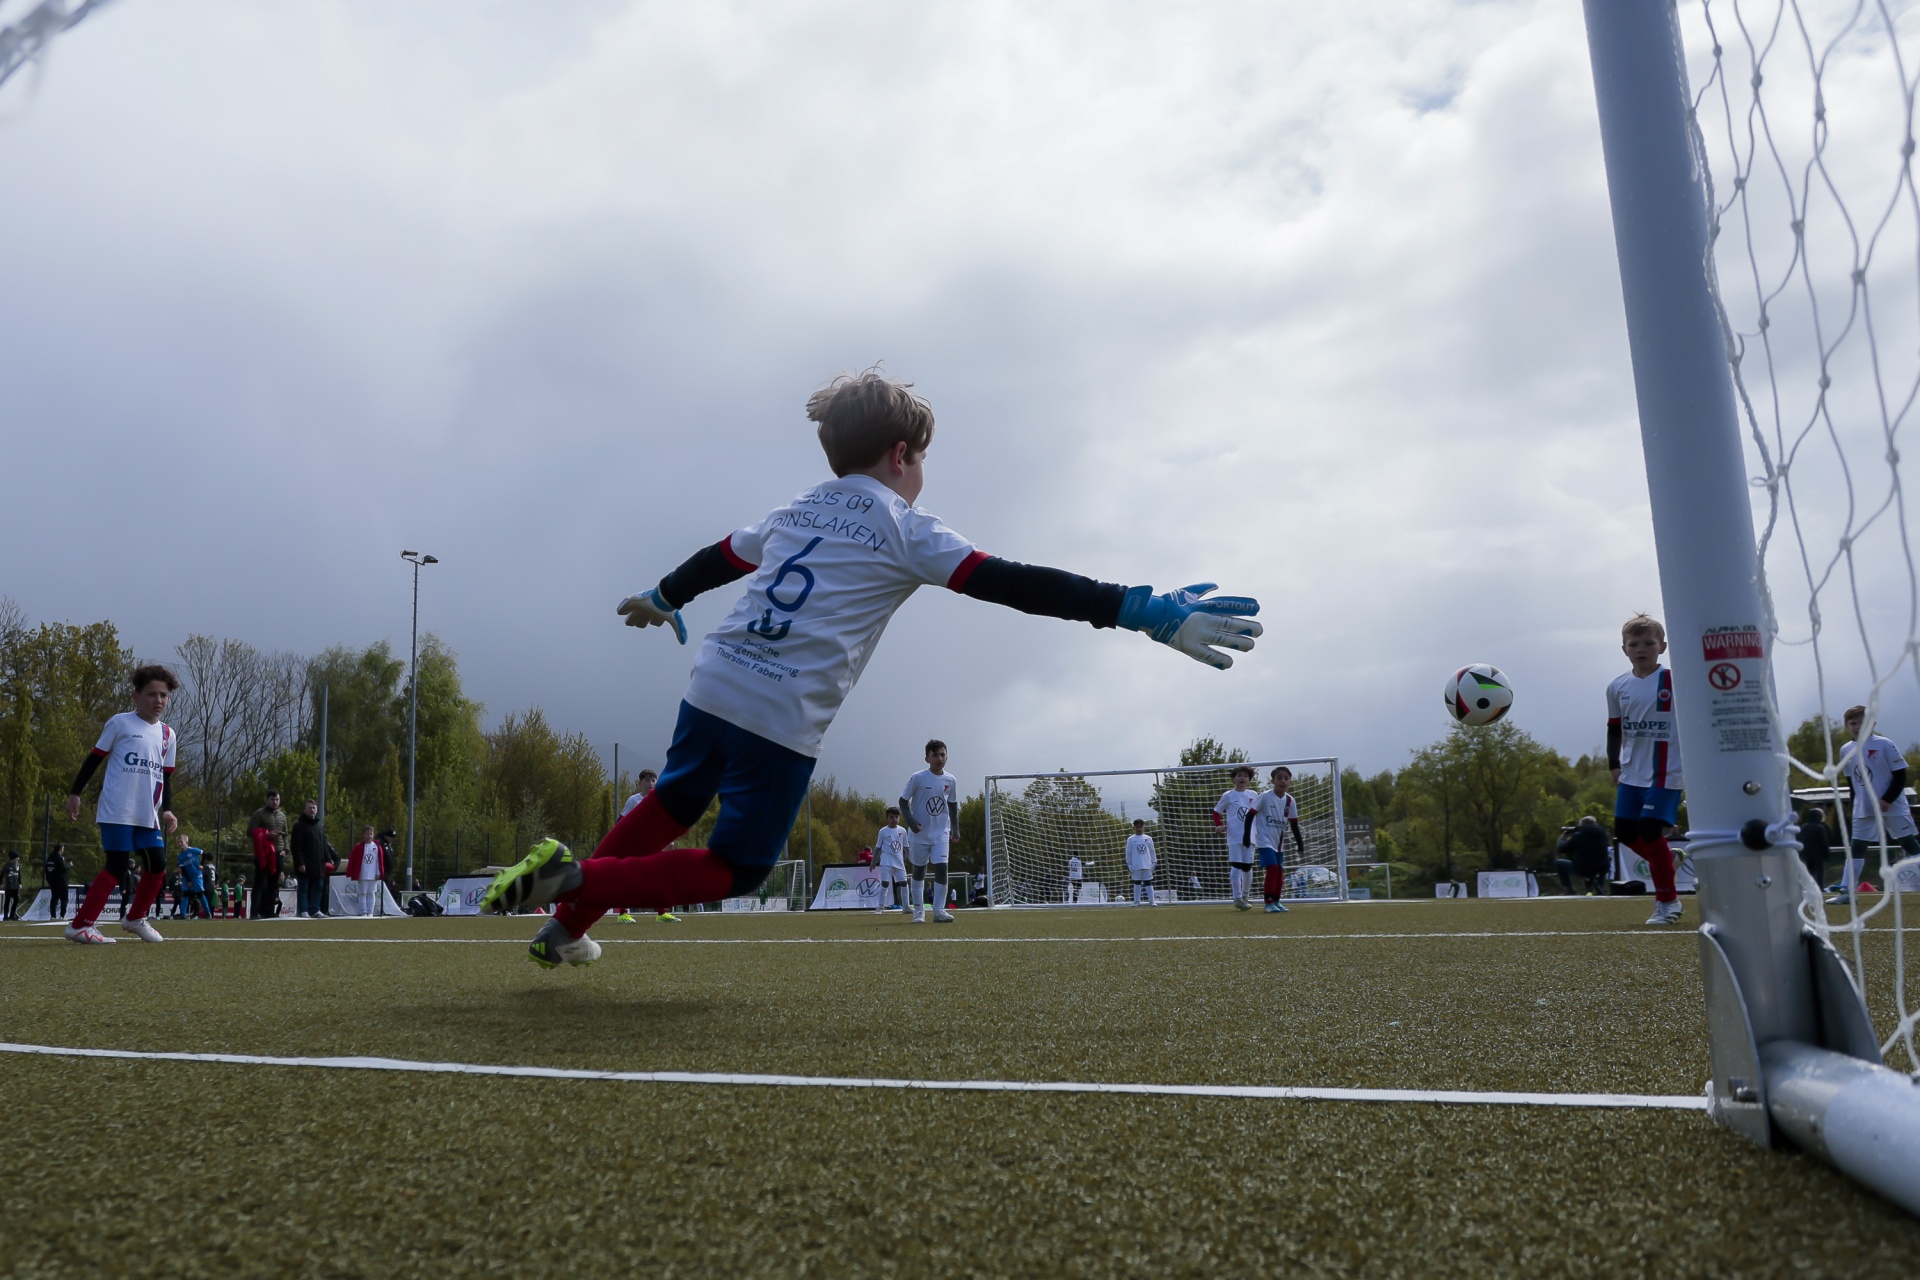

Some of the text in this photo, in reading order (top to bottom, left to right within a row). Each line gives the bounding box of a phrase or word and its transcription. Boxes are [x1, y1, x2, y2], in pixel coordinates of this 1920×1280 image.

[847, 494, 874, 515] 09
[769, 511, 886, 552] DINSLAKEN
[765, 536, 824, 613] 6
[1204, 600, 1255, 611] SPORTOUT
[1703, 633, 1761, 650] WARNING
[716, 646, 783, 682] Thorsten Fabert
